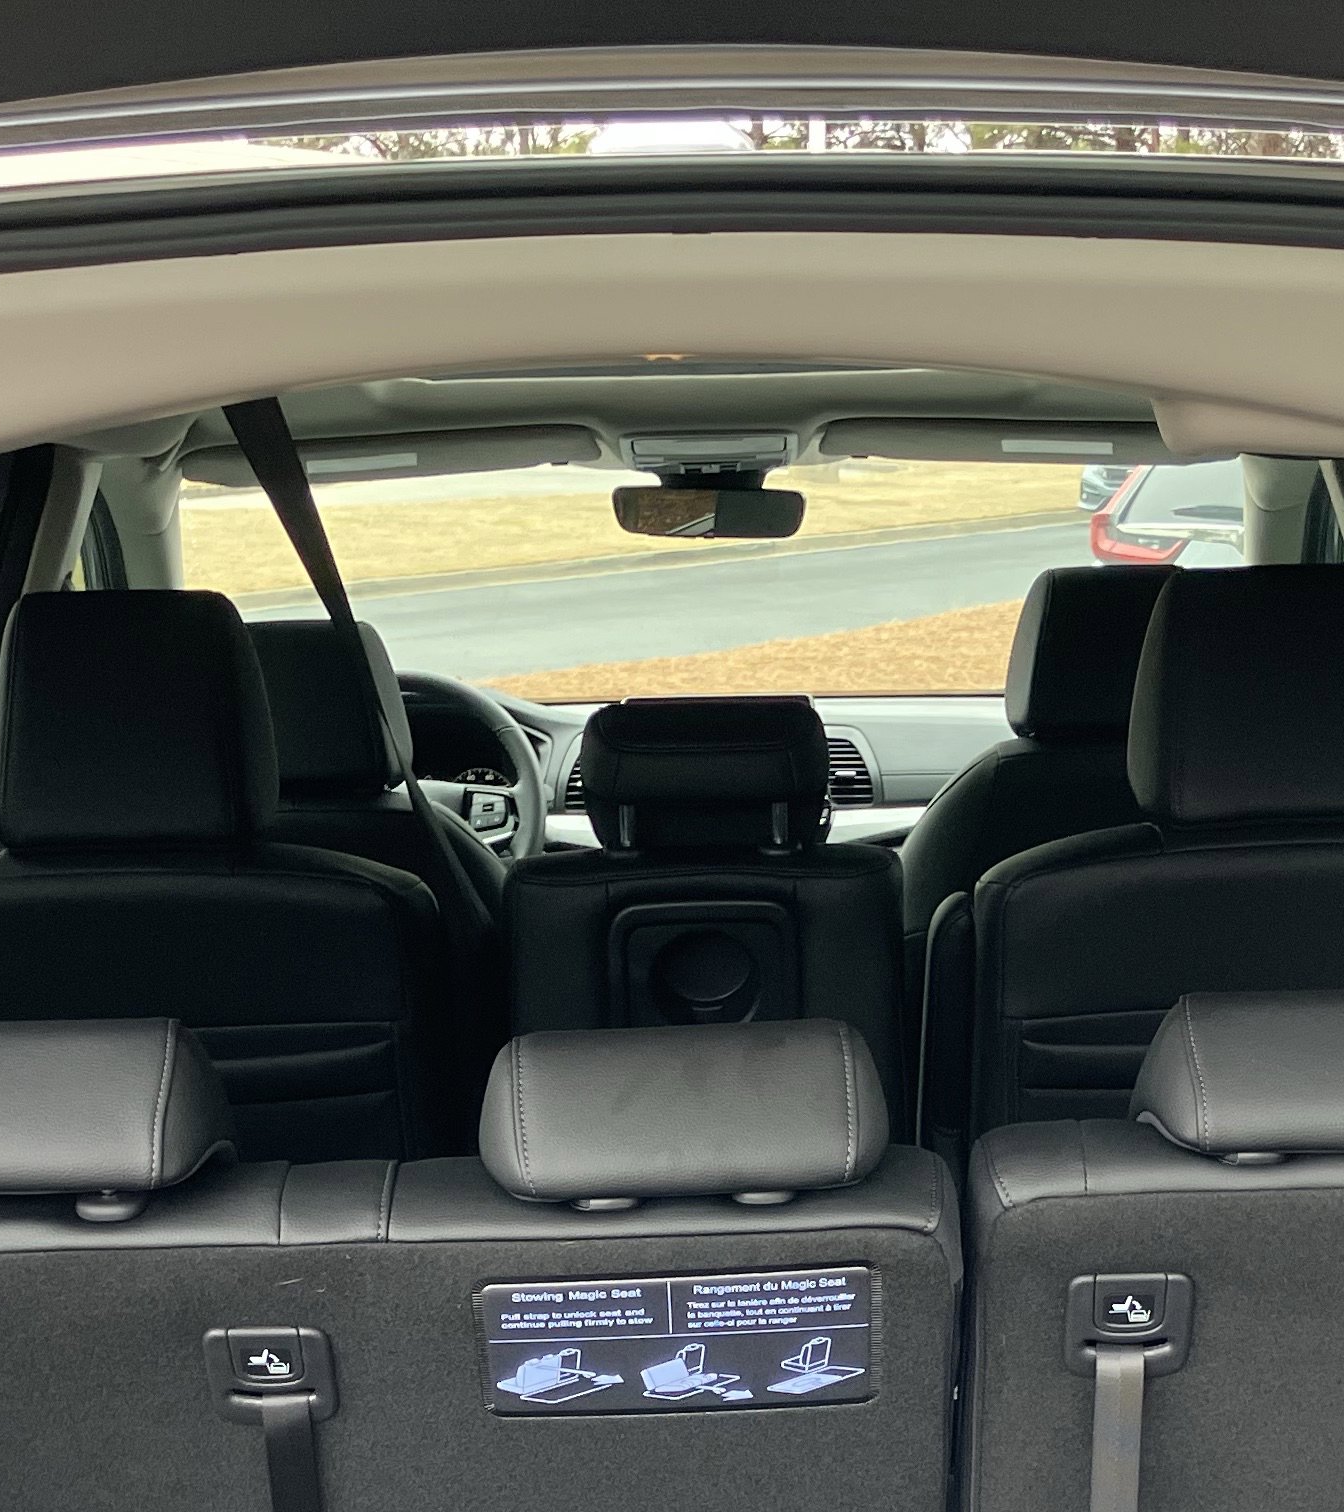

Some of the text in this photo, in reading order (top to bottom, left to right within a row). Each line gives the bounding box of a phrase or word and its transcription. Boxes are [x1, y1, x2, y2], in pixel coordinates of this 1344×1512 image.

[693, 1277, 847, 1296] Rangement du Magic Seat
[511, 1287, 642, 1303] Stowing Magic Seat
[727, 1299, 736, 1307] la
[787, 1296, 800, 1304] de
[500, 1313, 521, 1321] Pull
[523, 1312, 550, 1321] strap
[563, 1310, 597, 1319] unlock
[599, 1309, 622, 1317] seat
[625, 1307, 645, 1316] and
[501, 1317, 654, 1330] continue pulling firmly to stow
[736, 1317, 757, 1328] pour
[758, 1317, 767, 1325] la
[768, 1316, 798, 1326] ranger
